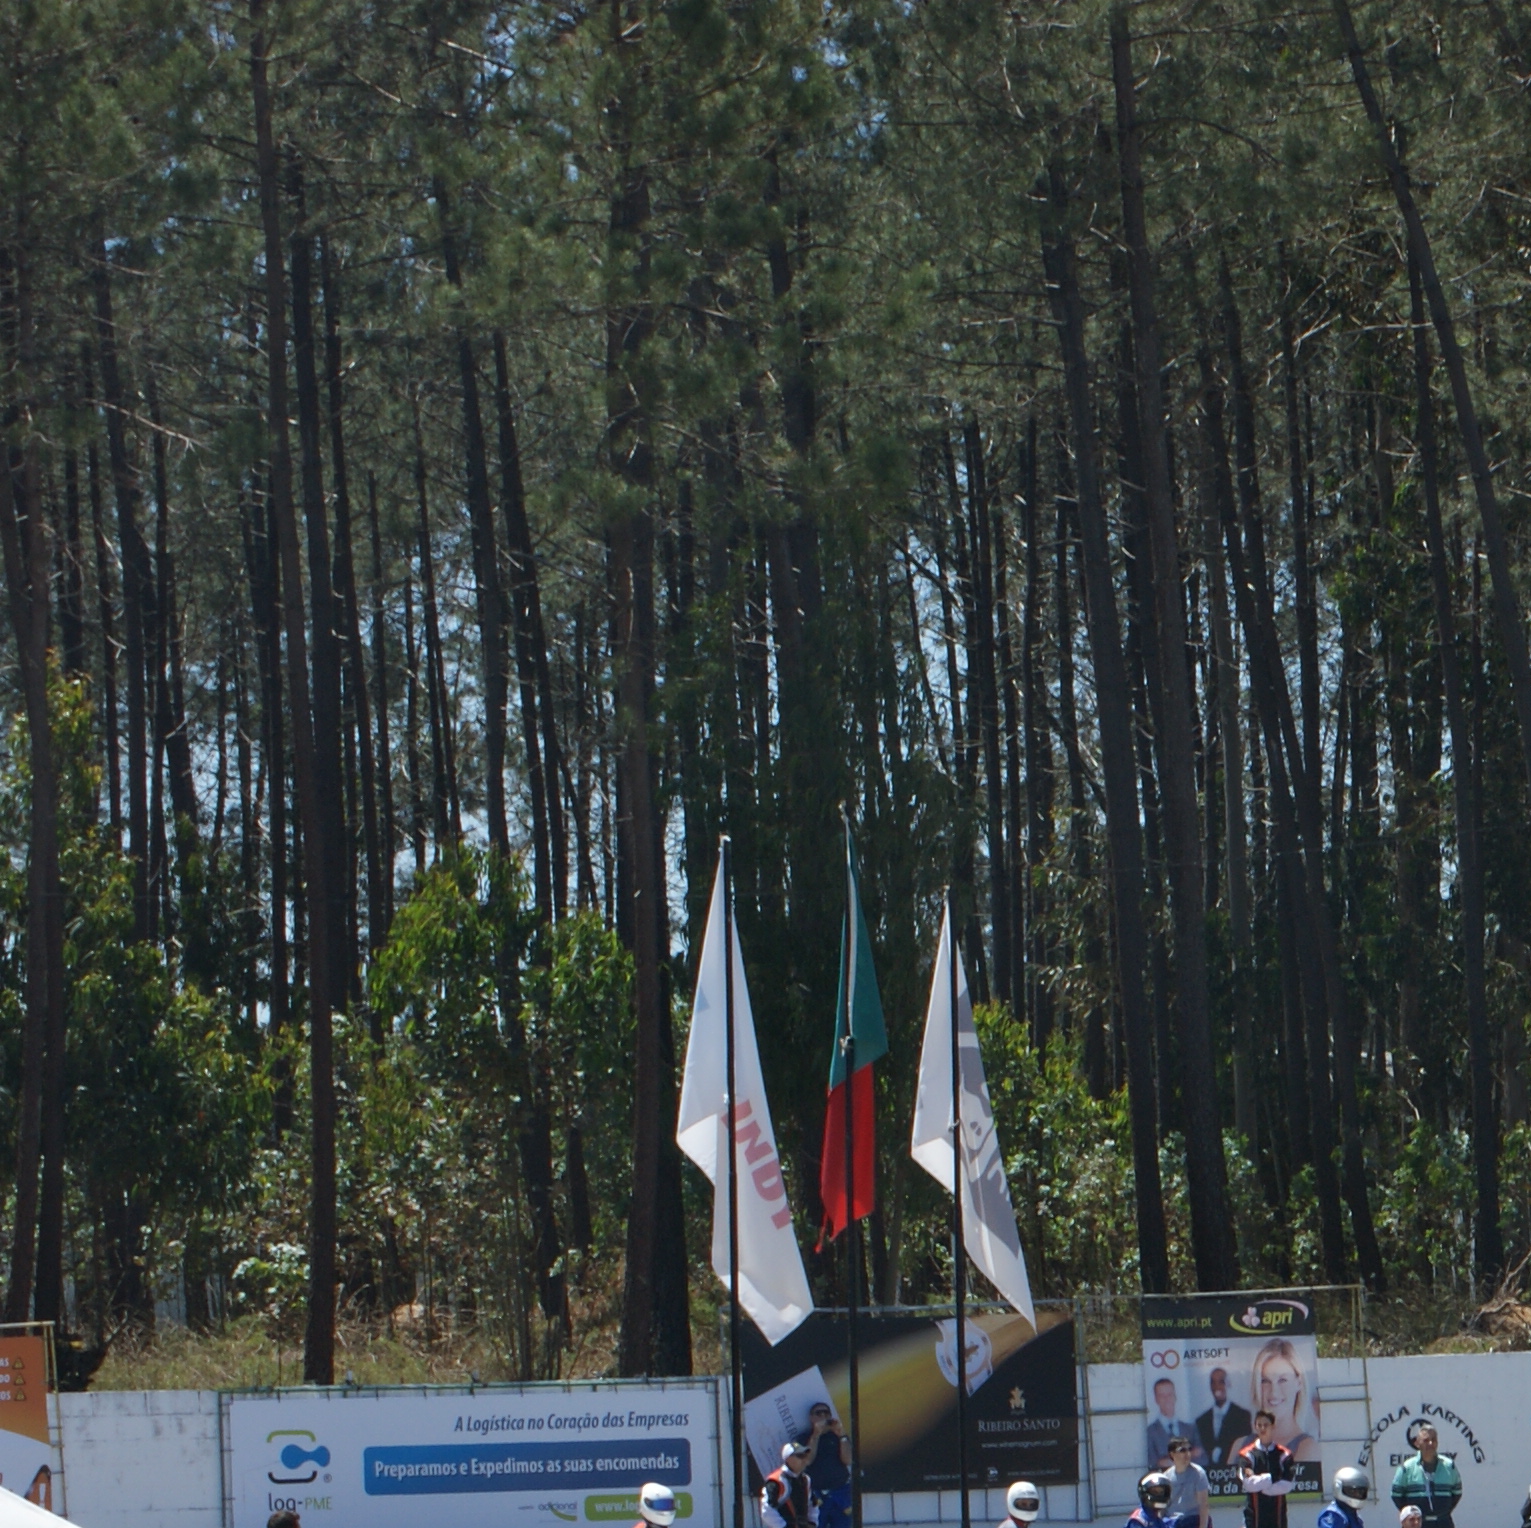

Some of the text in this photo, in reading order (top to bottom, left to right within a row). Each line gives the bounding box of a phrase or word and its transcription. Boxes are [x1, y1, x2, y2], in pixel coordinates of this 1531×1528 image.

[1146, 1307, 1294, 1329] www.apri.pt apri
[1184, 1347, 1231, 1360] ARTSOFT
[454, 1410, 690, 1436] A Logística no Coração das Empresas
[1358, 1402, 1486, 1467] ESCOLA KARTING
[375, 1452, 680, 1481] Preparamos e Expedimos as suas encomendas
